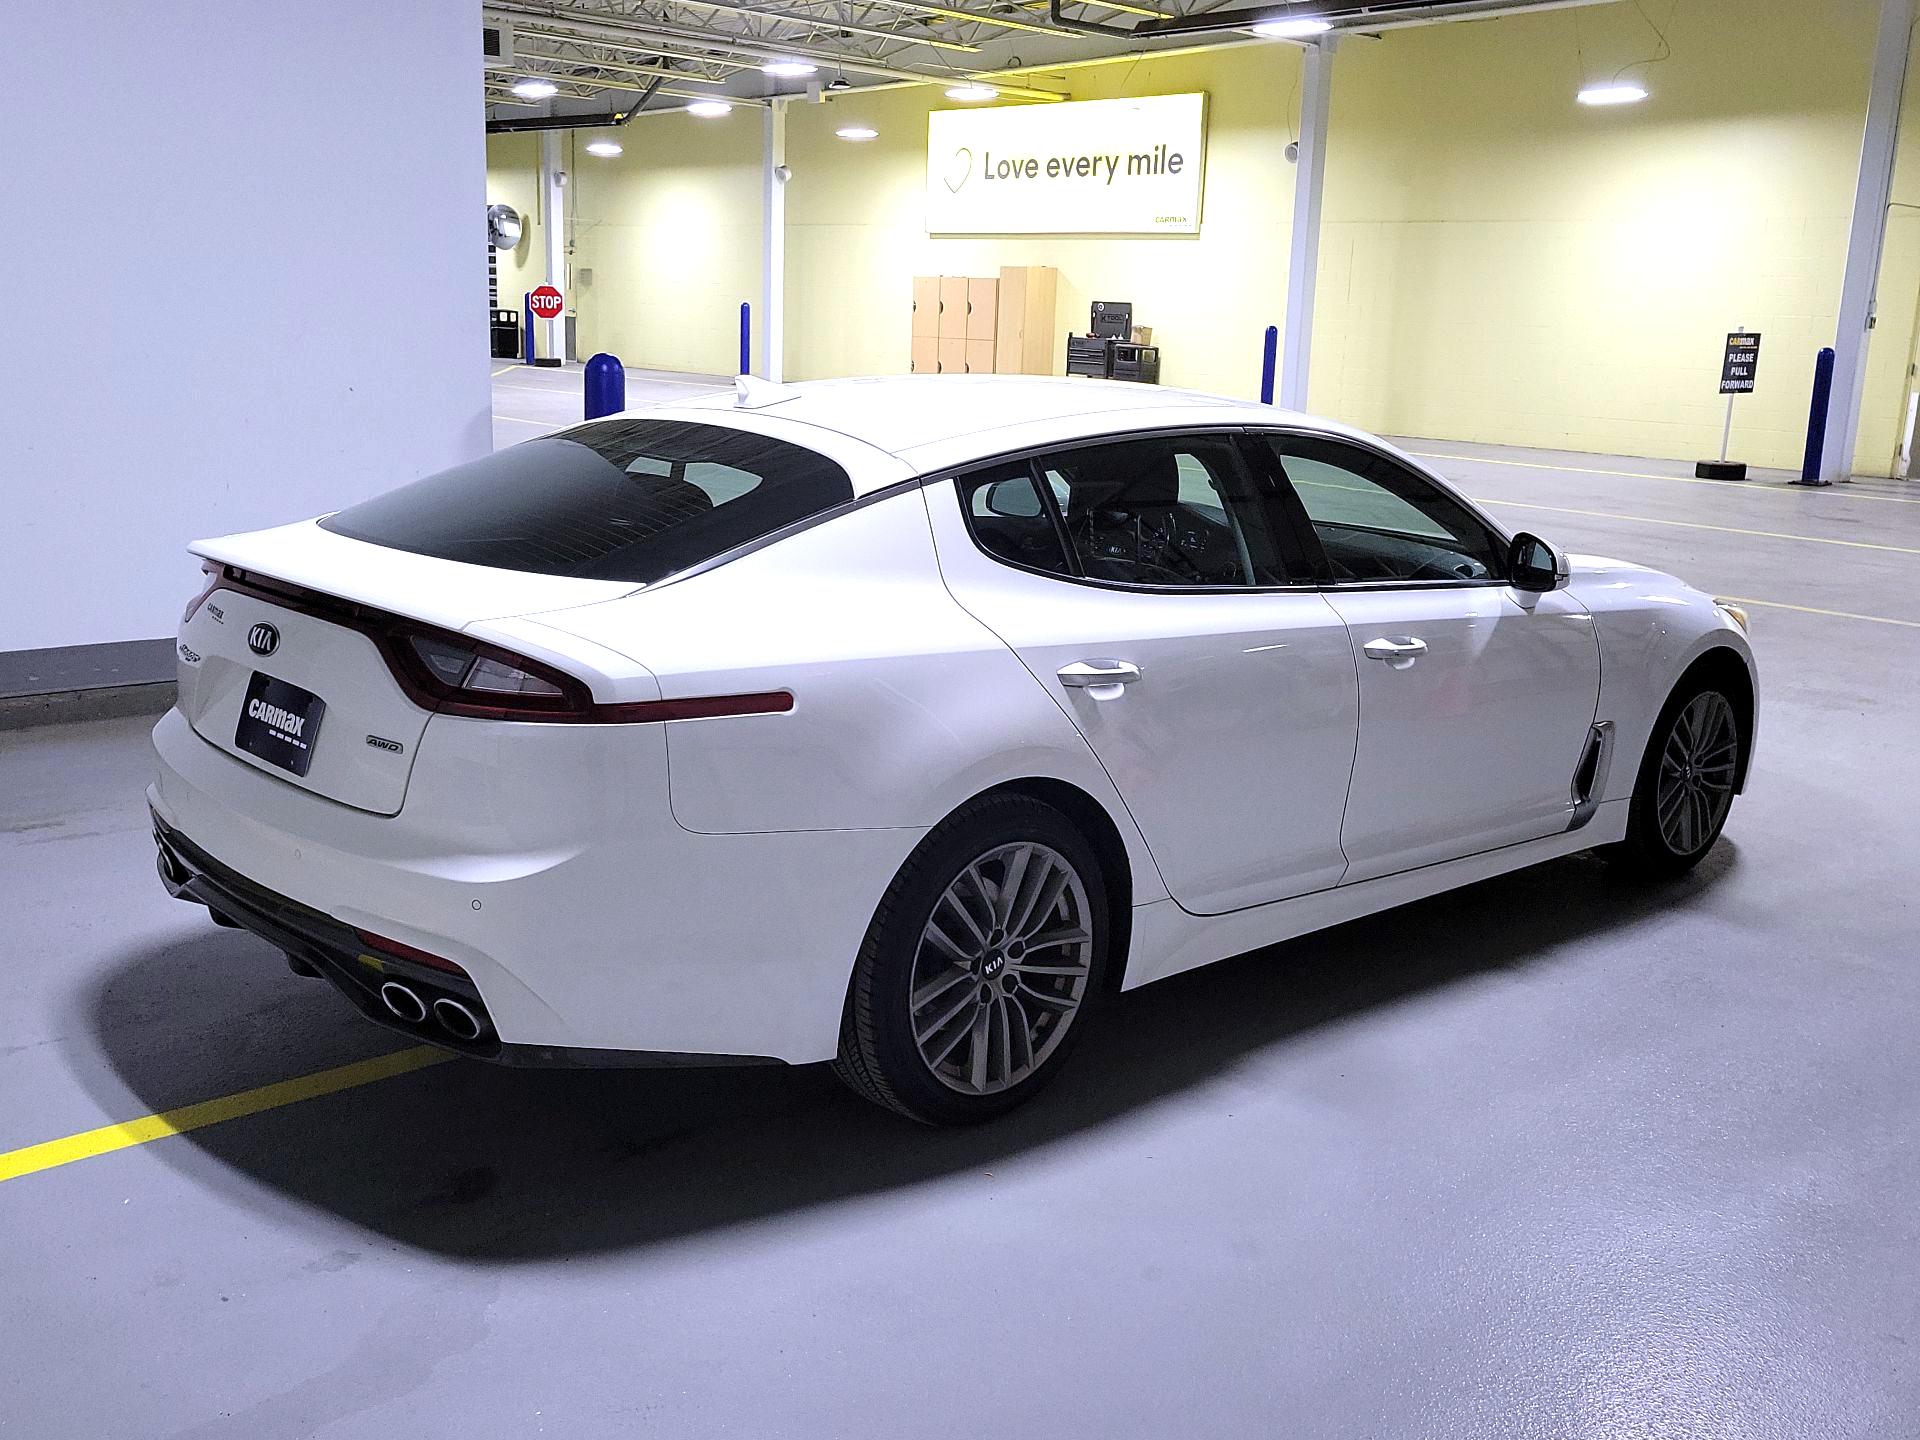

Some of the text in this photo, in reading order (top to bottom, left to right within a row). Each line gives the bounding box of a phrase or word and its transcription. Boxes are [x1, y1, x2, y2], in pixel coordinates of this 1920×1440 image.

[984, 144, 1184, 185] Love every mile
[531, 295, 562, 310] STOP
[1728, 353, 1755, 363] PLEASE
[1730, 366, 1748, 376] PULL
[1721, 379, 1754, 390] FORWARD
[250, 625, 273, 651] KIA
[367, 737, 400, 752] AWD
[984, 956, 1004, 975] KIA
